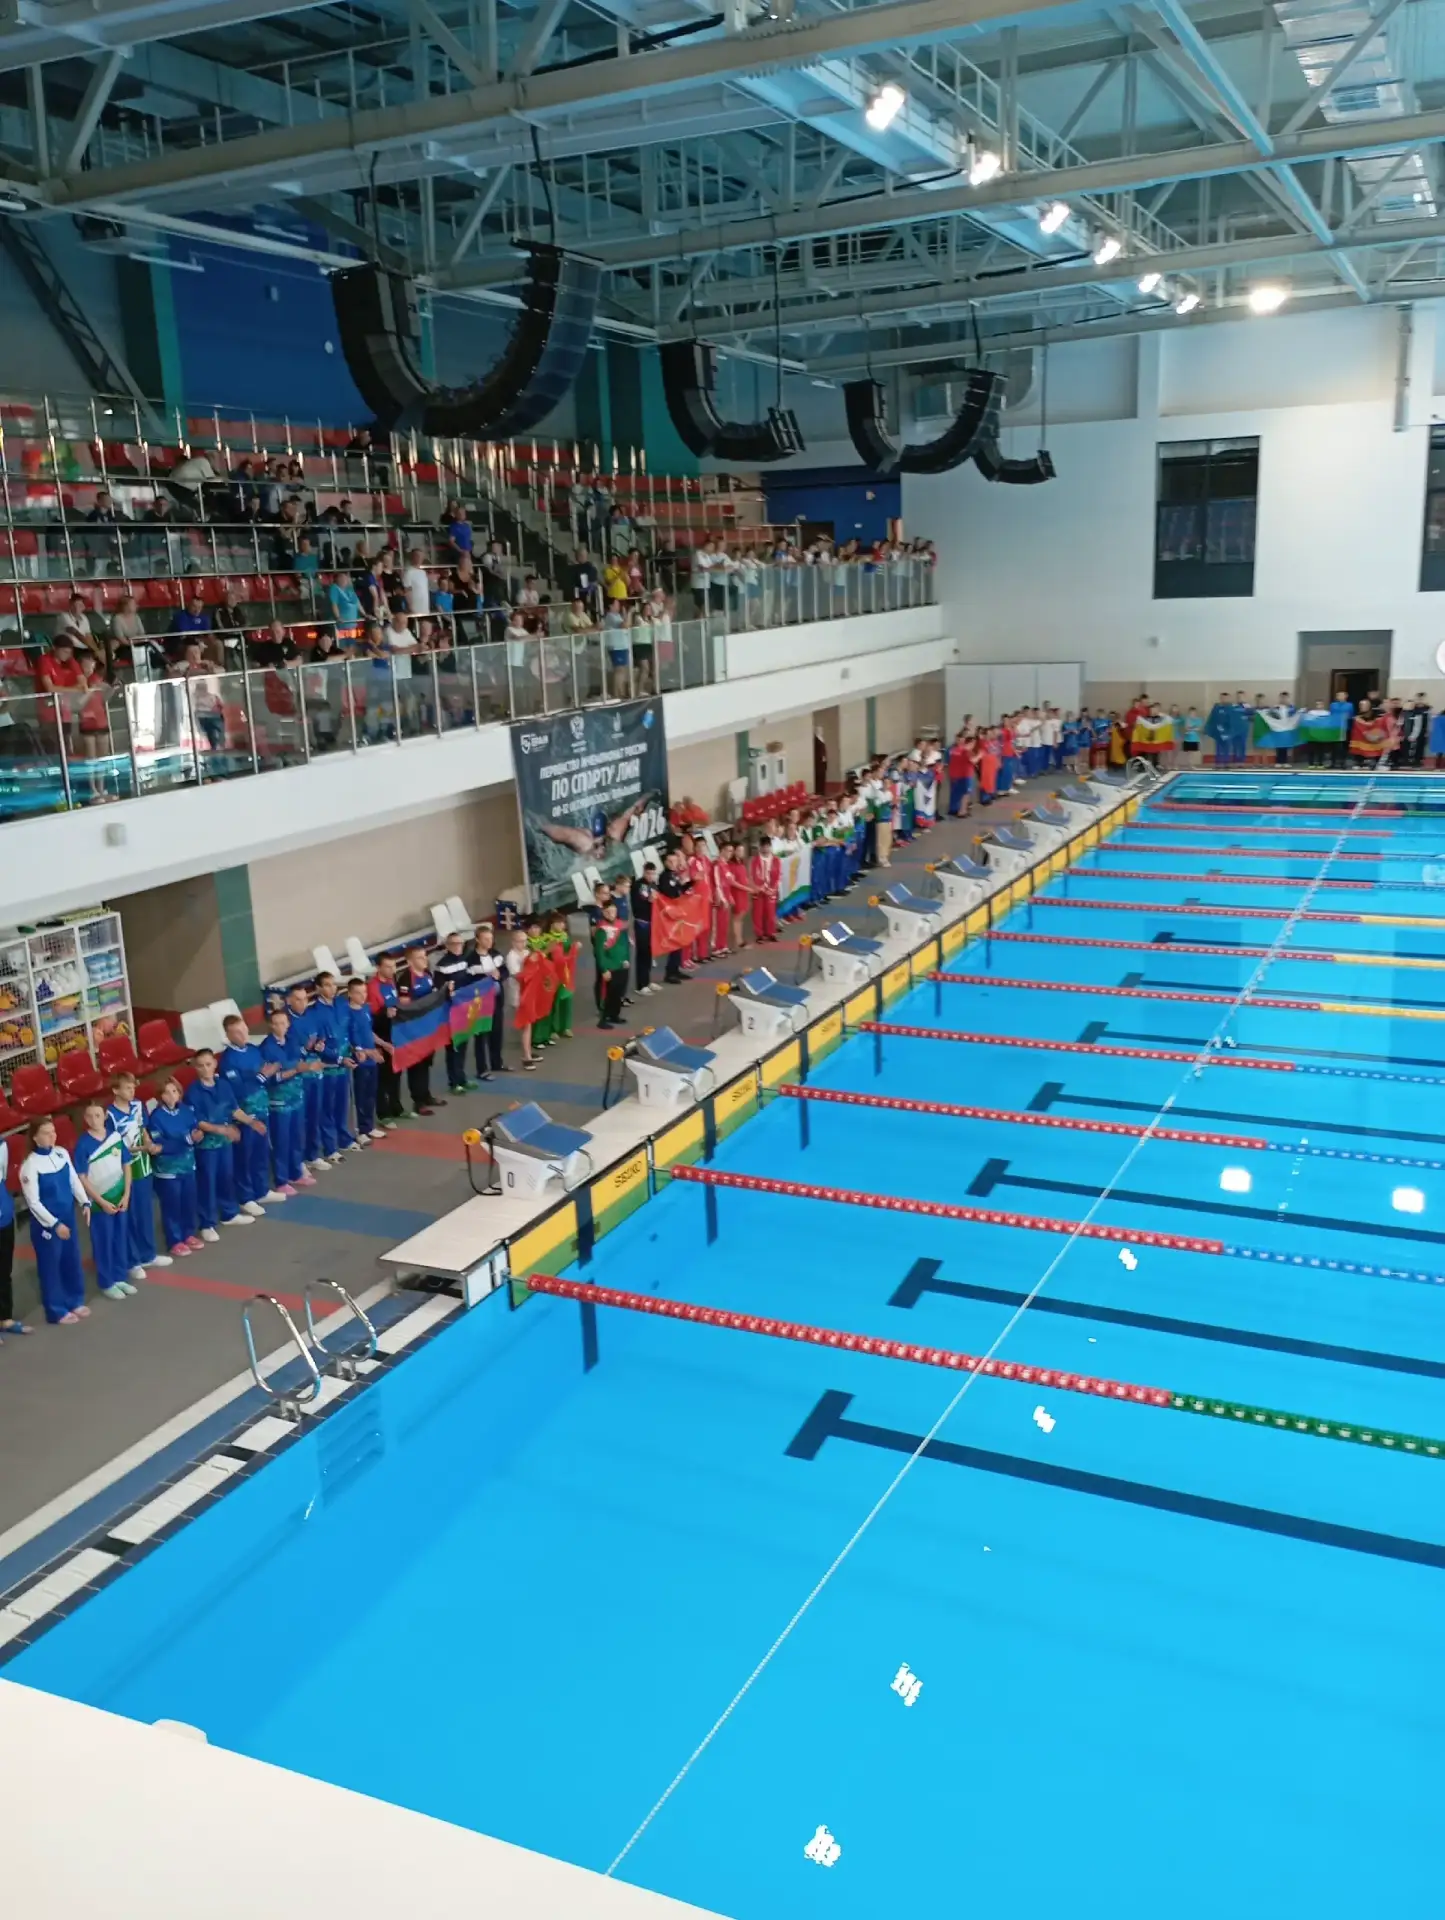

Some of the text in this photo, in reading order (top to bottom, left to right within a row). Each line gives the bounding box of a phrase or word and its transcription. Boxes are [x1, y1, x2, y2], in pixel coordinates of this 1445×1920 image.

[551, 779, 569, 800] ПО
[571, 765, 615, 794] СПОРТУ
[644, 1083, 649, 1097] 1
